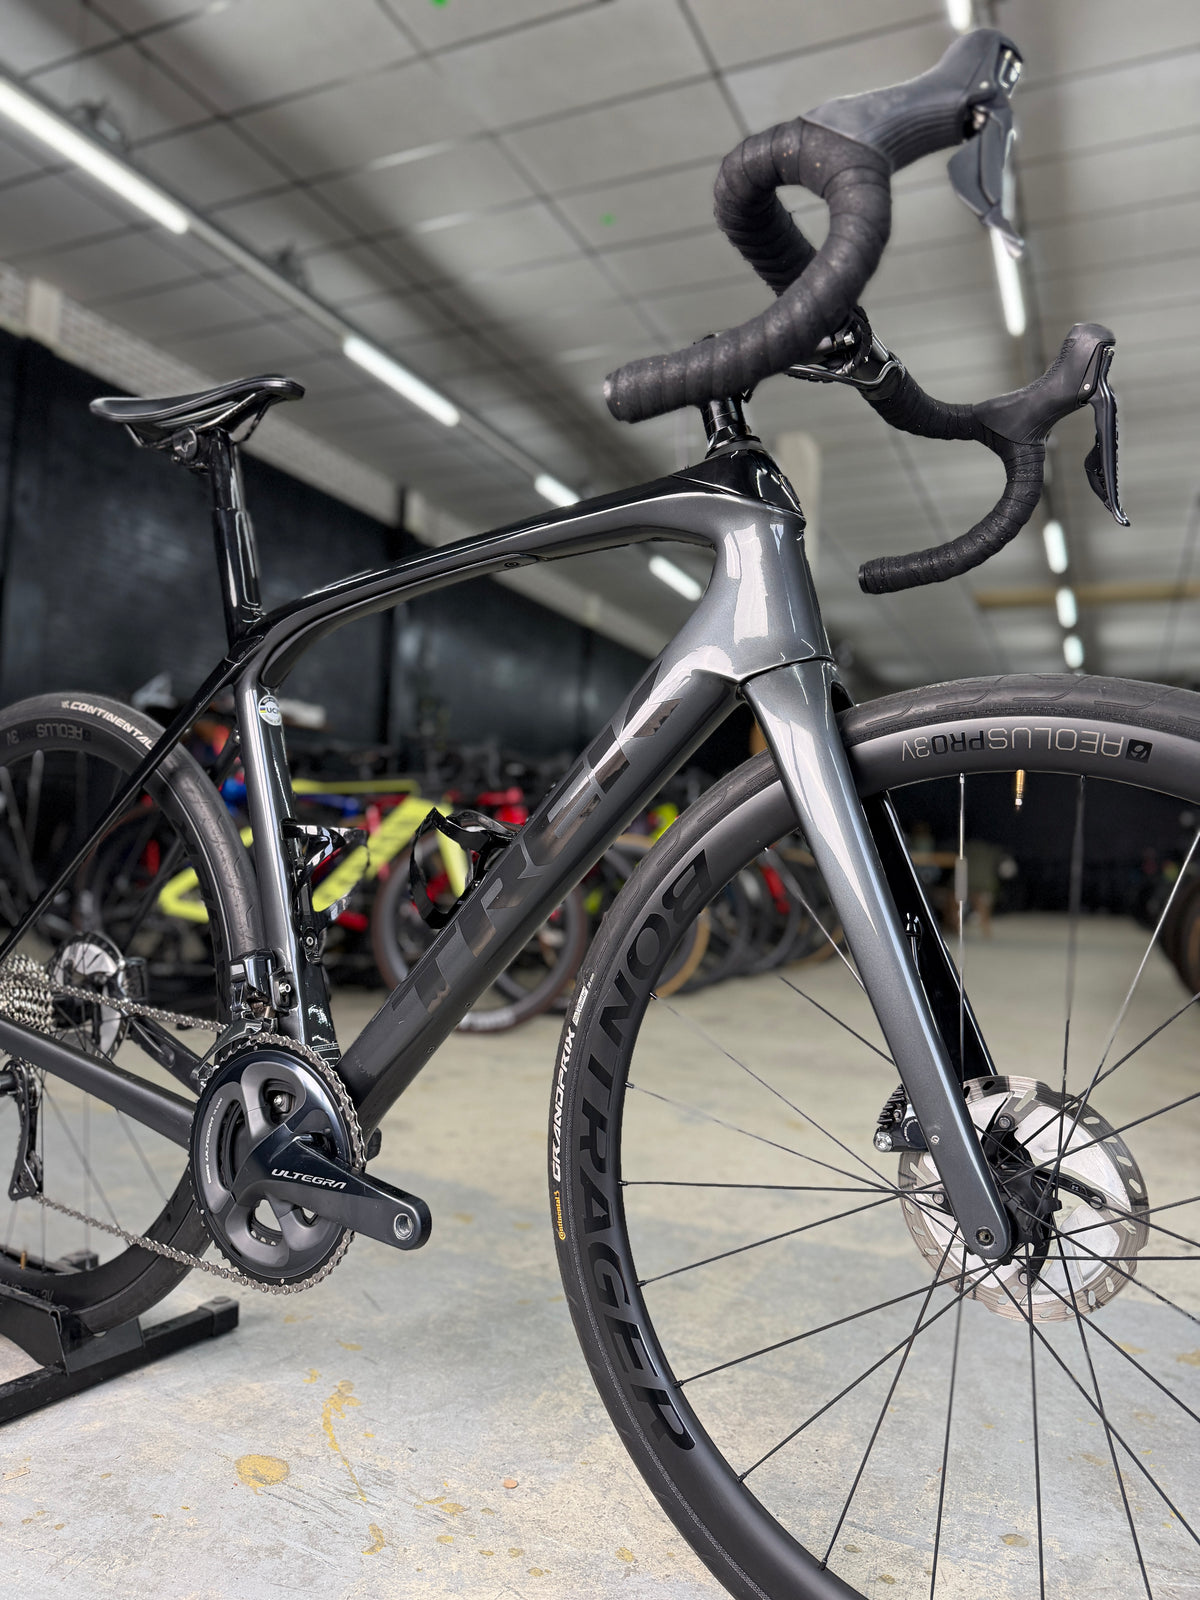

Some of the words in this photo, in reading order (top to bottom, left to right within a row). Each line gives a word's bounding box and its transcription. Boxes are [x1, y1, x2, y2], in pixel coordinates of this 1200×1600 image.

[69, 701, 153, 751] CONTINENTAL
[391, 660, 683, 1014] TREK
[579, 848, 712, 1451] BONTRAGER
[271, 1168, 347, 1190] ULTEGRA
[554, 1196, 567, 1241] Continental
